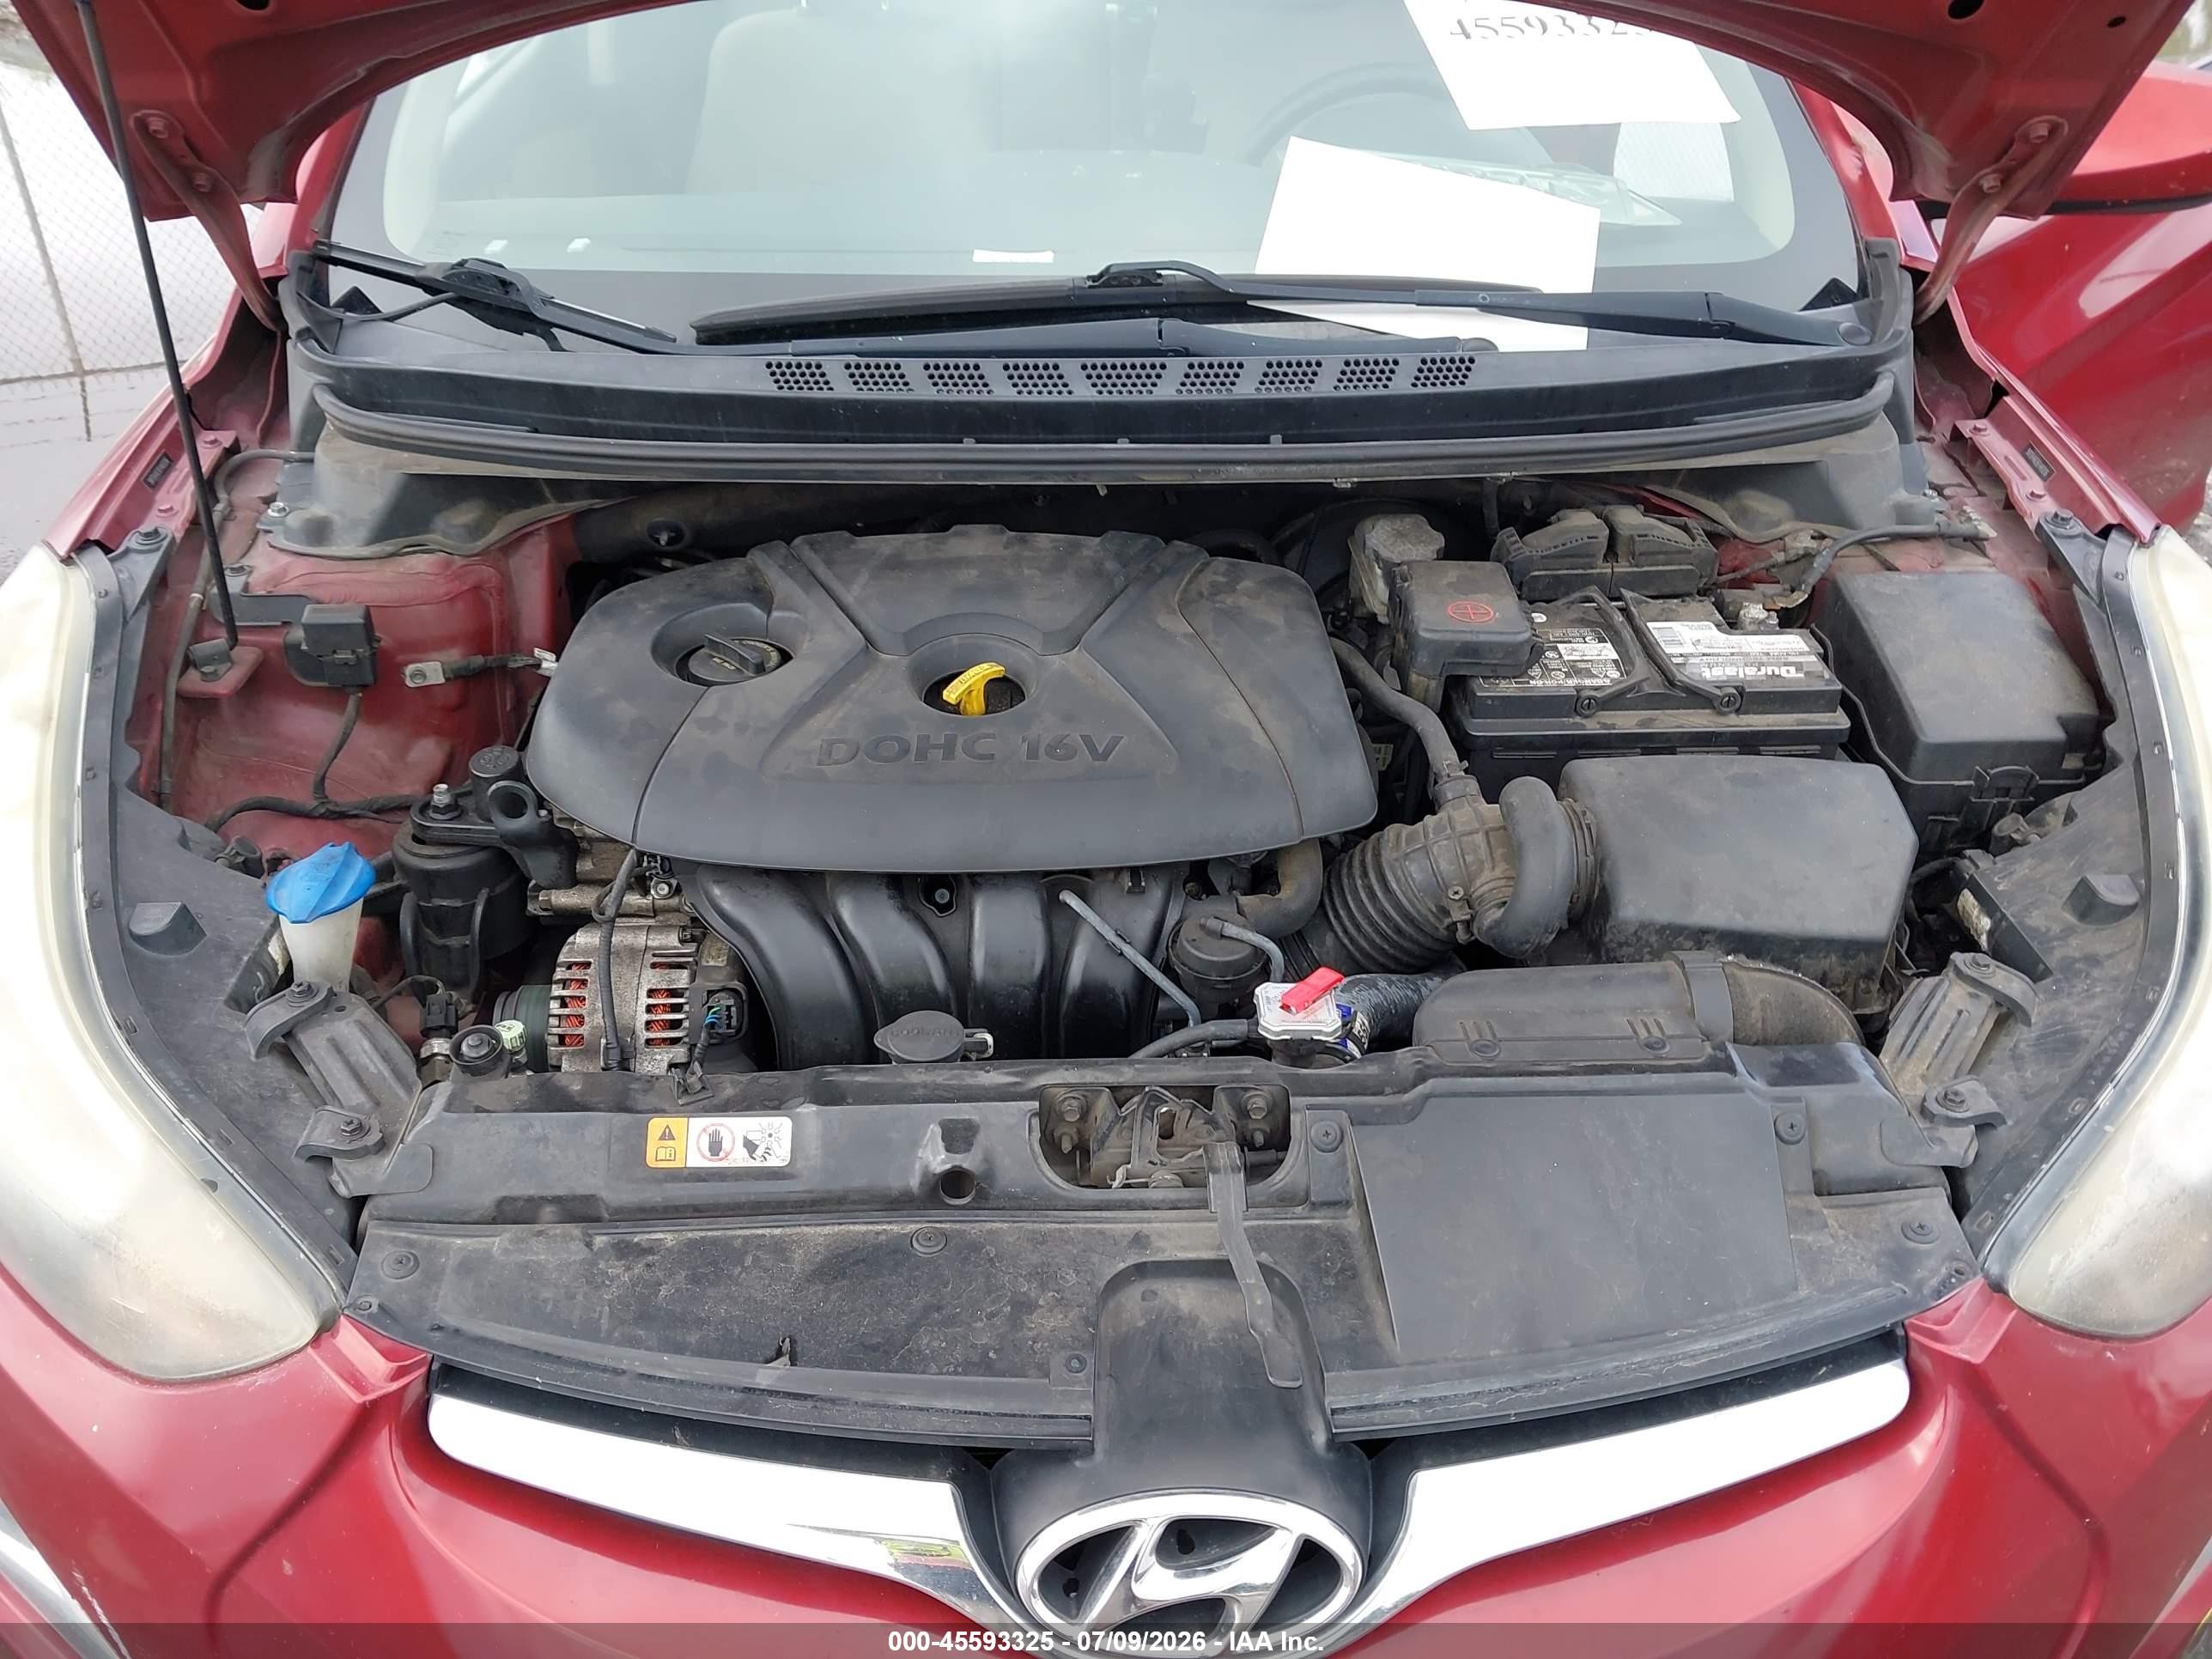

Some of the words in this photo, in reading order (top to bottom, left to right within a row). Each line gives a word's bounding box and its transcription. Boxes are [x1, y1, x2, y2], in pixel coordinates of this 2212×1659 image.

[1449, 15, 1652, 39] 4559332
[1701, 665, 1805, 679] Duralast
[816, 732, 997, 767] DOHC
[1020, 732, 1125, 763] 16V
